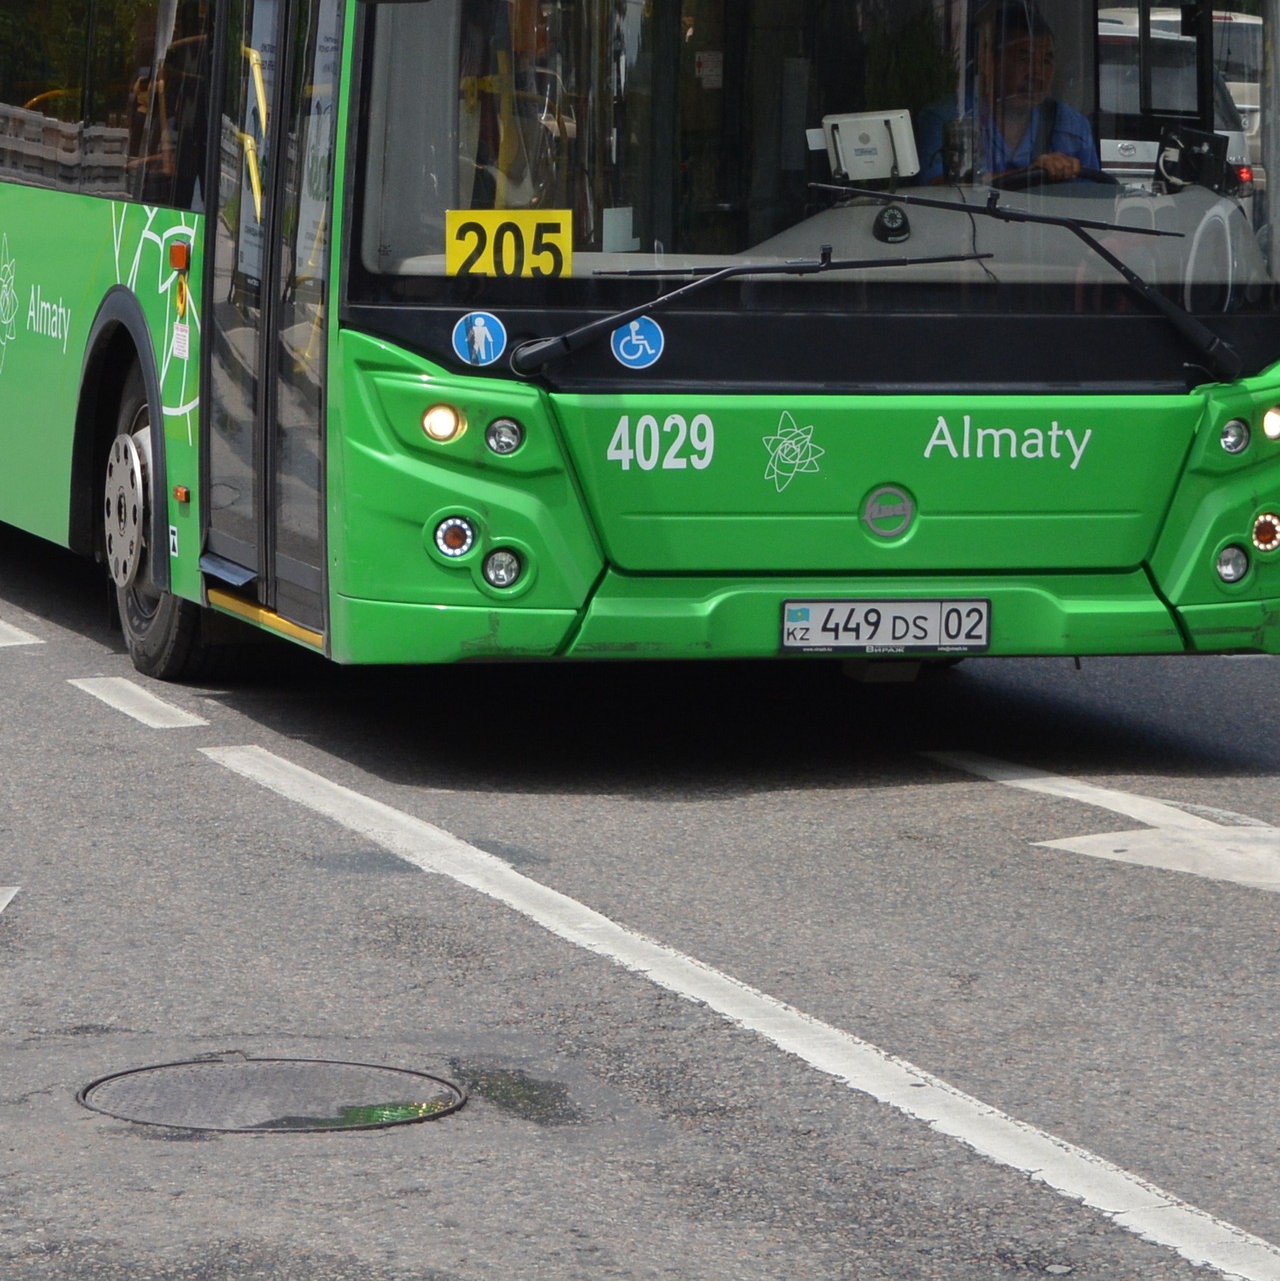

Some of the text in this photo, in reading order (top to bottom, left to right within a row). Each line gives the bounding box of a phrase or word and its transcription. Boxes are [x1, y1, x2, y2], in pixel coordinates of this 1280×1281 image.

[455, 221, 564, 278] 205
[26, 284, 71, 355] Almaty
[607, 413, 1093, 471] 4029 Almaty
[786, 607, 984, 641] KZ 449 DS 02
